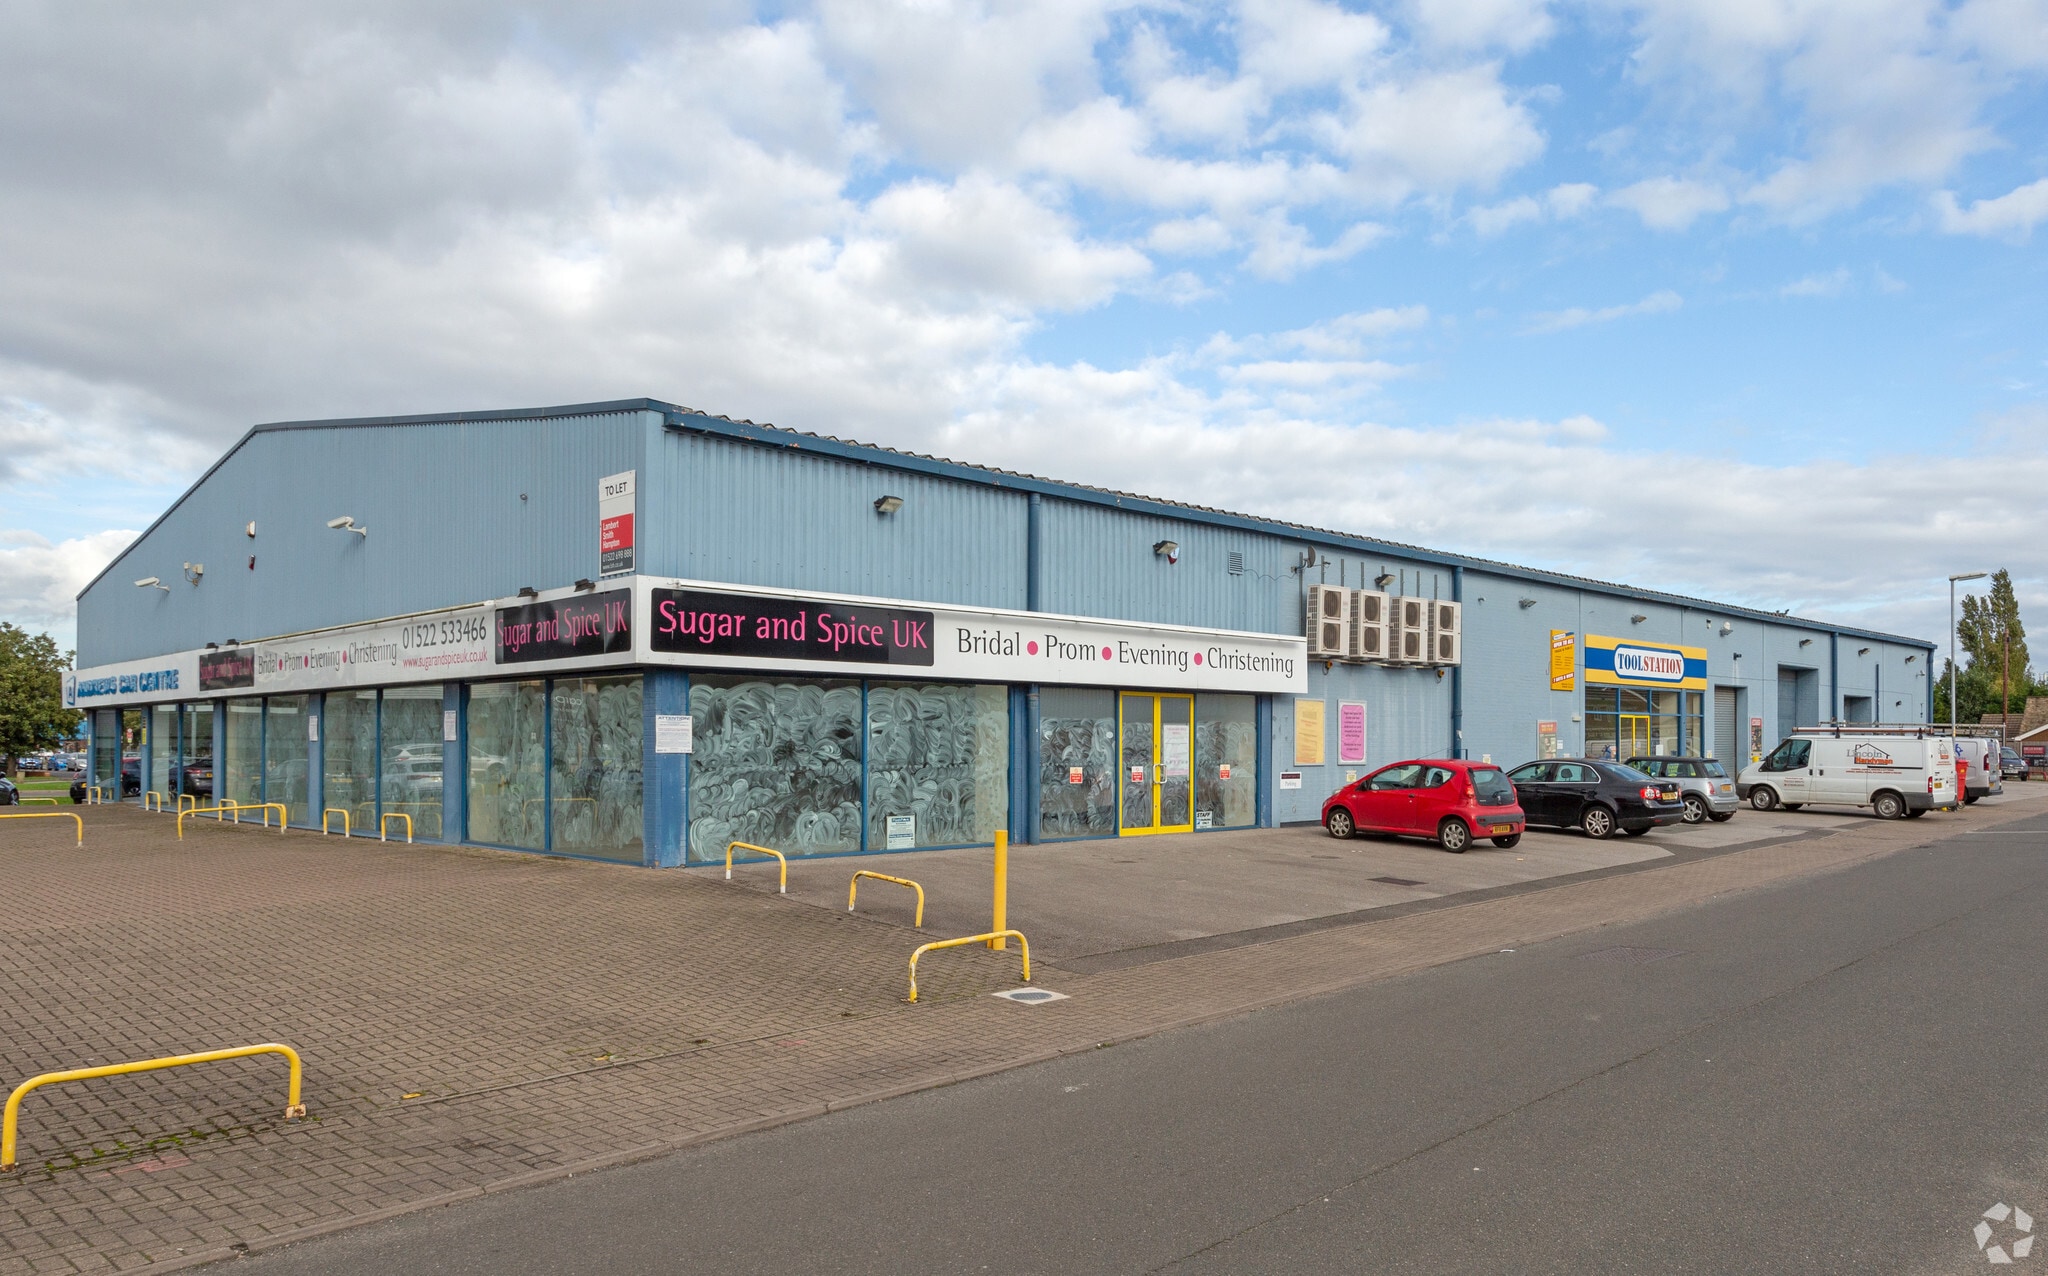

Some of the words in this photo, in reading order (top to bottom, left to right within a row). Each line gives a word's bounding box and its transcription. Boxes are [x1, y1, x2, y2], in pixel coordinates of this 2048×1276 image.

[605, 485, 614, 496] TO
[615, 482, 627, 494] LET
[602, 520, 619, 531] Lambert
[602, 531, 614, 540] Smith
[602, 539, 620, 549] Hampton
[602, 551, 615, 563] 01522
[402, 623, 437, 649] 01522
[441, 616, 487, 645] 533466
[498, 618, 531, 653] Sugar
[536, 611, 559, 642] and
[564, 606, 600, 647] Spice
[605, 600, 627, 634] UK
[659, 600, 745, 644] Sugar
[755, 611, 806, 641] and
[817, 613, 884, 651] Spice
[891, 619, 928, 650] UK
[258, 655, 278, 675] Bridal
[284, 652, 303, 671] Prom
[310, 647, 340, 671] Evening
[349, 638, 397, 666] Christening
[402, 649, 488, 671] www.sugarandspiceuk.co.uk
[957, 627, 1020, 656] Bridal
[1045, 634, 1096, 661] Prom
[1118, 641, 1189, 672] Evening
[1207, 647, 1294, 678] Christening
[1617, 653, 1682, 674] TOOLSTATION
[77, 676, 117, 698] ANDREWS
[119, 674, 138, 694] CAR
[139, 669, 179, 692] CENTRE
[1846, 749, 1882, 758] Lincoln
[1856, 757, 1893, 765] Handyman
